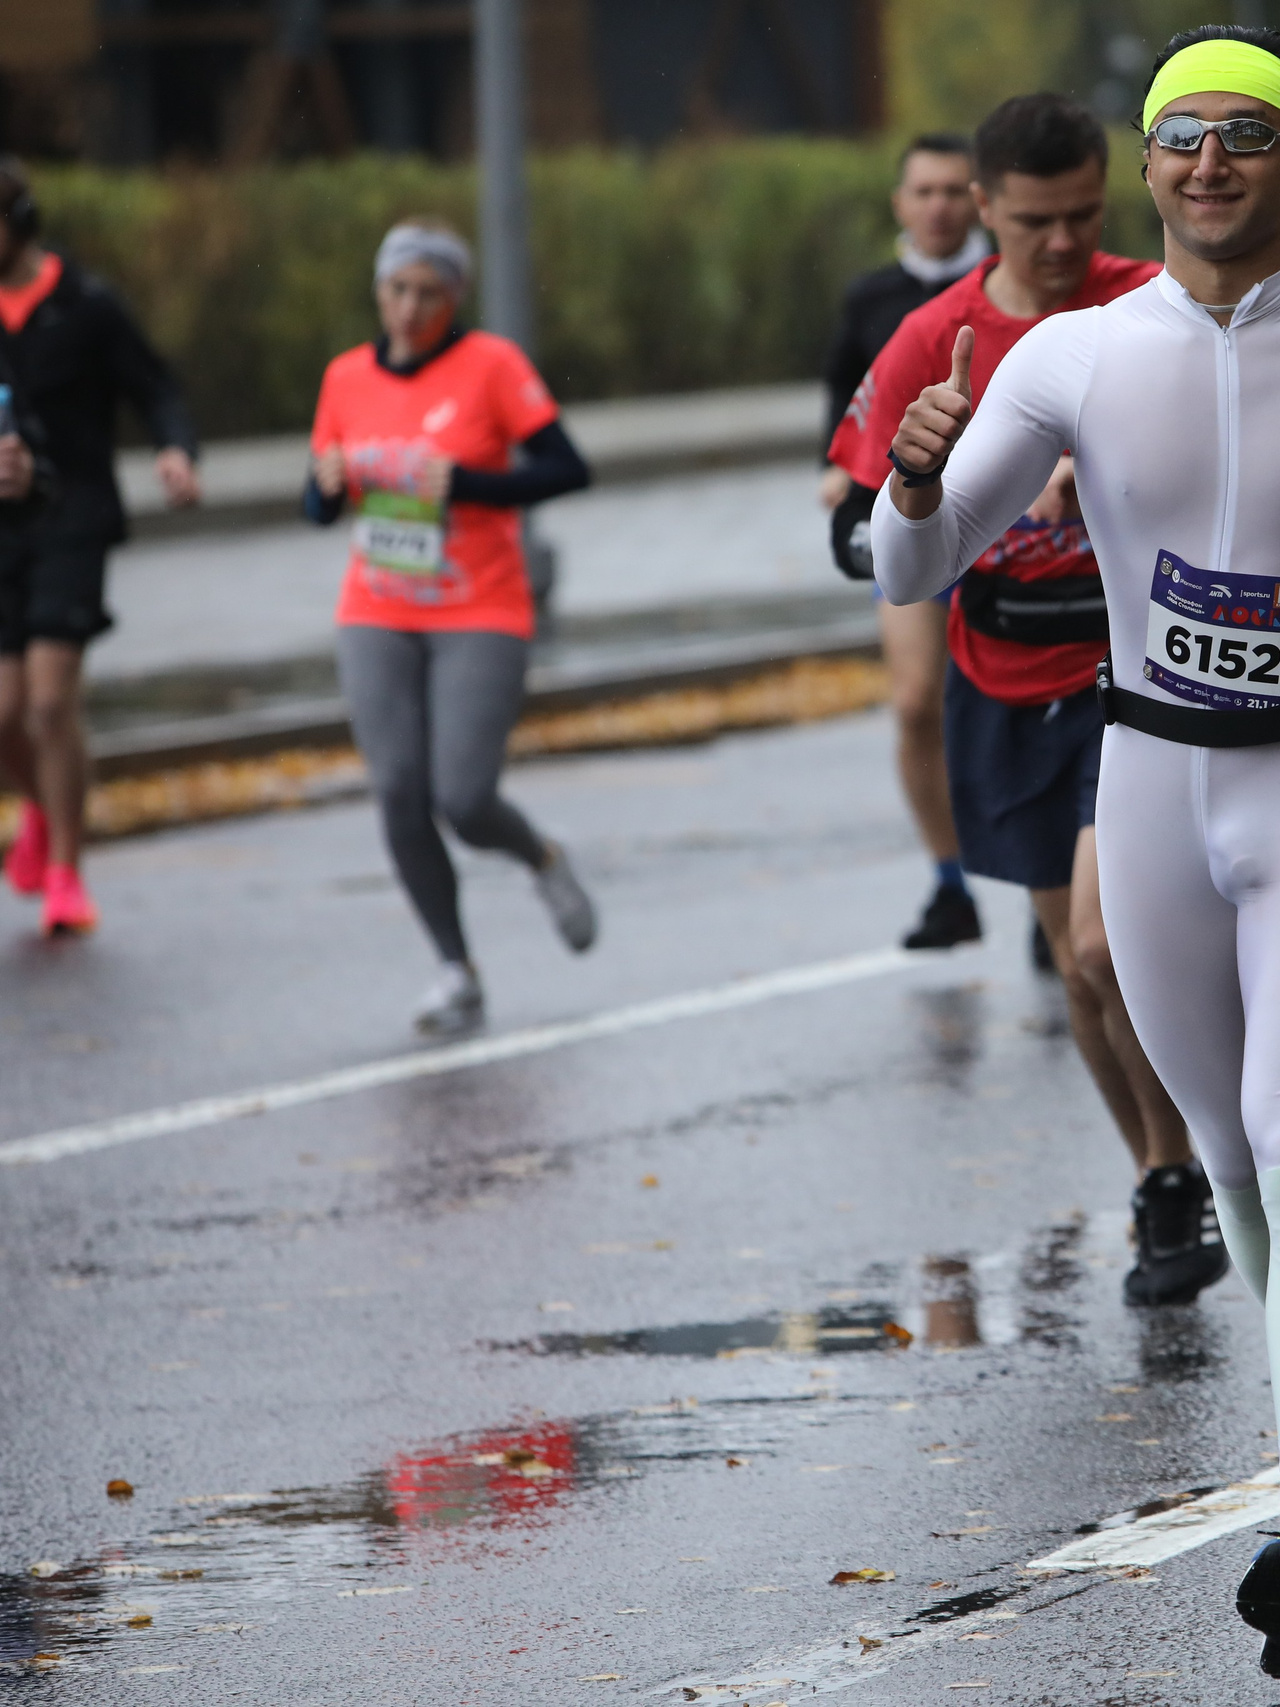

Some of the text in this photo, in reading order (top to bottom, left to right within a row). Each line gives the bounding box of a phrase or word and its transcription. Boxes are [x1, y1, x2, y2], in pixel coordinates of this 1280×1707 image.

[1167, 589, 1203, 608] Полумарафон
[1209, 590, 1224, 598] ANTA
[1247, 698, 1268, 709] 21.1
